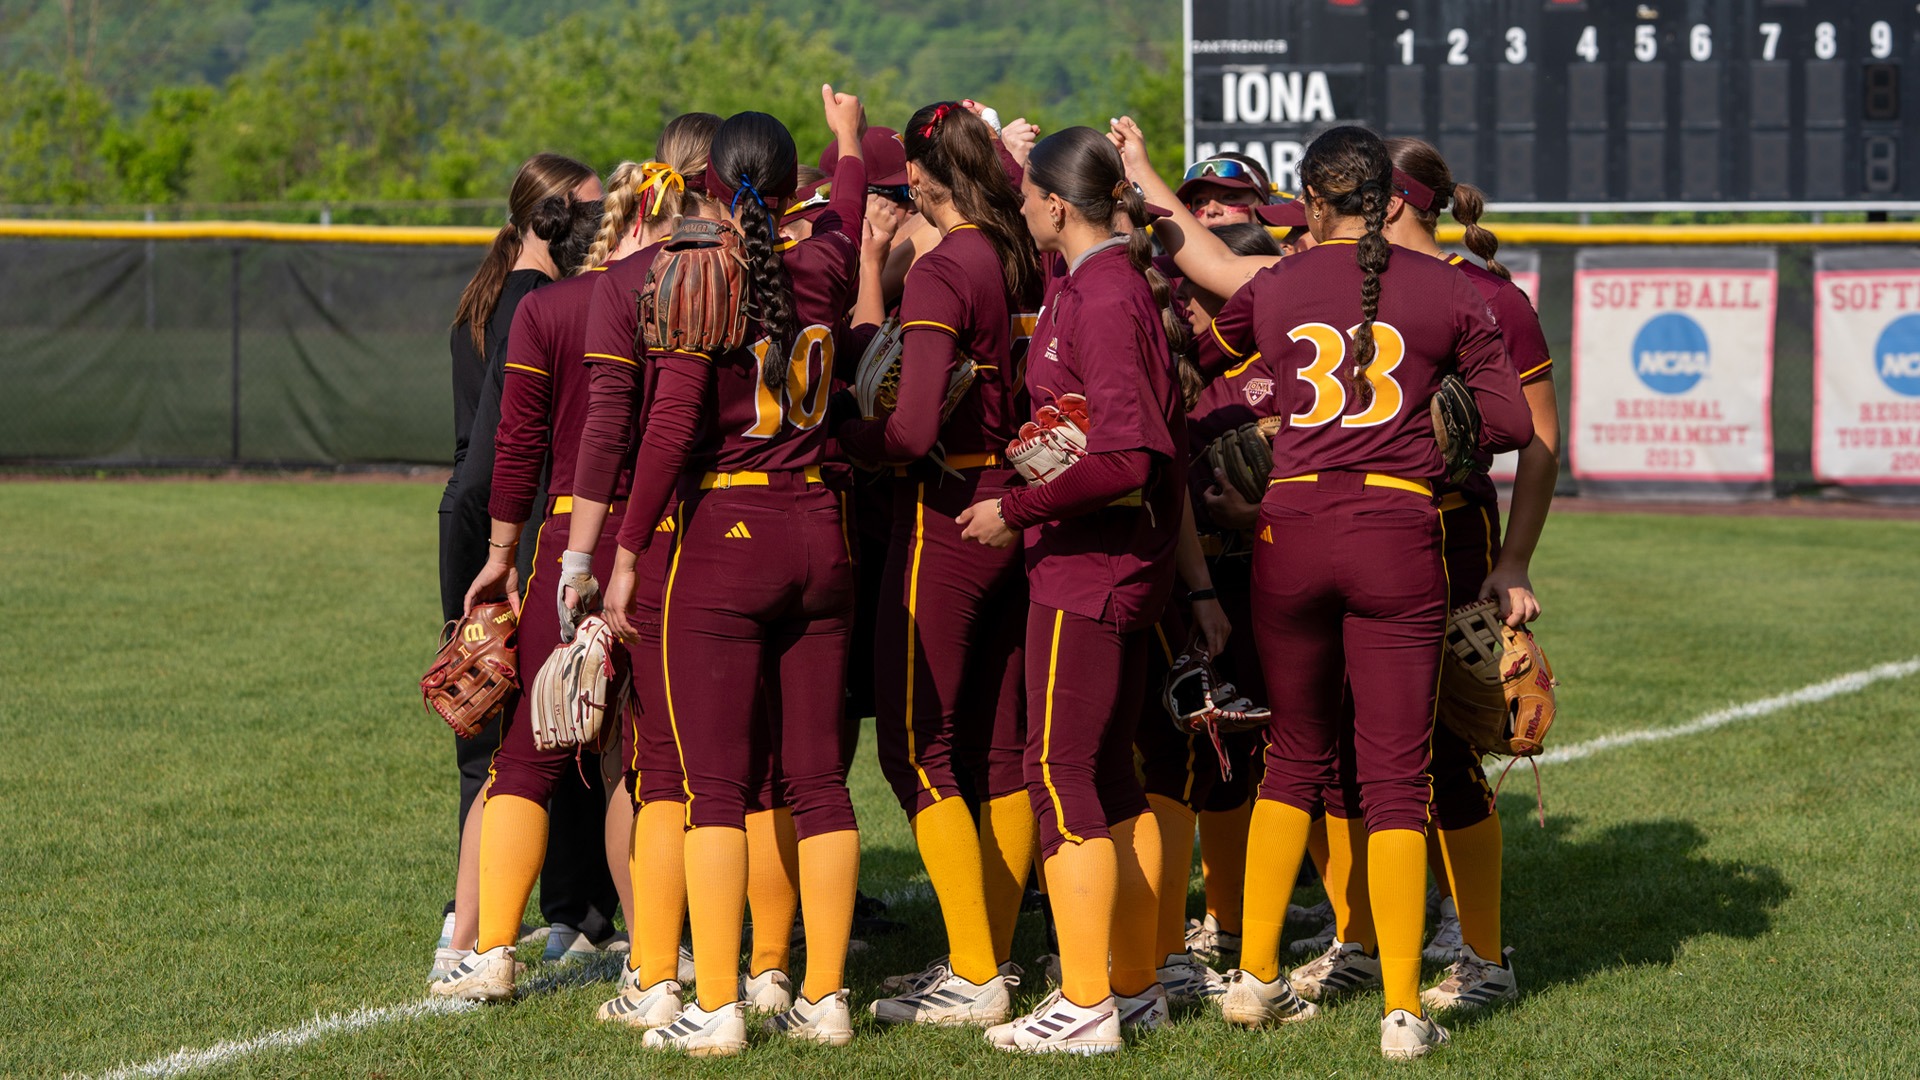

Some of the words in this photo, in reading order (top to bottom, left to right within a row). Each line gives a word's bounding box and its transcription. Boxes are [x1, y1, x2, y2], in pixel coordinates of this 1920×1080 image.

[1397, 29, 1414, 65] 1
[1447, 28, 1469, 65] 2
[1505, 27, 1527, 64] 3
[1576, 26, 1599, 62] 4
[1634, 25, 1657, 62] 5
[1690, 24, 1712, 61] 6
[1759, 23, 1781, 61] 7
[1815, 22, 1837, 60] 8
[1870, 21, 1892, 59] 9
[1222, 71, 1336, 123] IONA
[1590, 281, 1762, 309] SOFTBALL
[1831, 281, 1920, 311] SOFT
[1286, 321, 1406, 430] 33
[1640, 351, 1709, 376] NCAA
[741, 324, 834, 439] 10
[1616, 400, 1723, 420] REGIONAL
[1591, 424, 1749, 443] TOURNAMENT
[1524, 703, 1543, 740] Wilson
